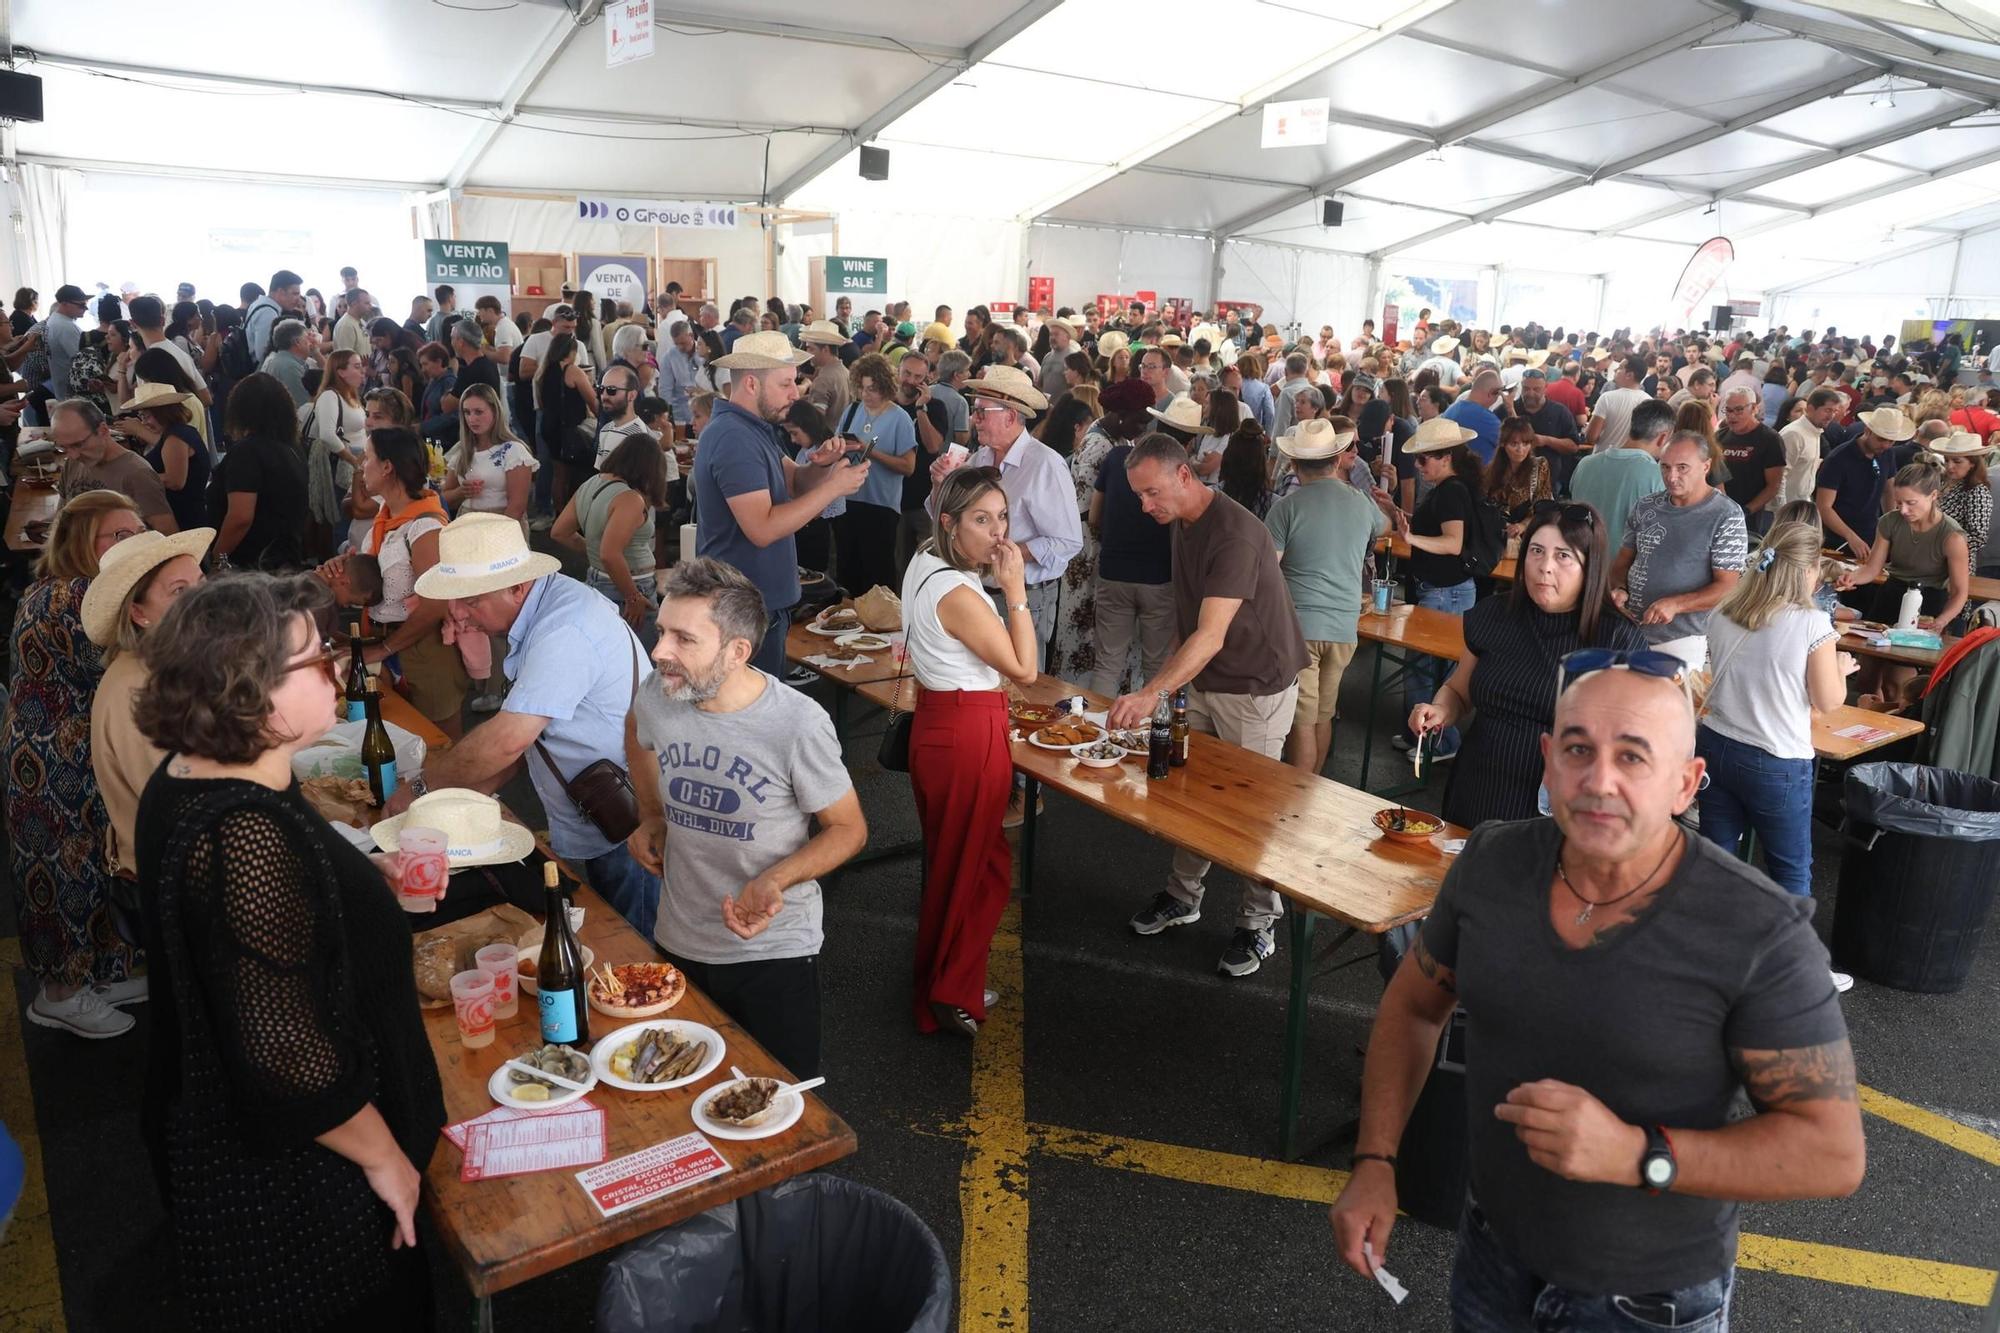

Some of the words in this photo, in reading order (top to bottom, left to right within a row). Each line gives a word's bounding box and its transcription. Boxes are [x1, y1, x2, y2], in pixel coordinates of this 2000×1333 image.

[441, 244, 497, 260] VENTA
[436, 263, 459, 278] DE
[462, 262, 504, 279] VIÑO
[842, 260, 875, 273] WINE
[595, 273, 632, 284] VENTA
[842, 276, 874, 289] SALE
[607, 287, 622, 298] DE
[657, 742, 721, 775] POLO
[724, 755, 772, 805] RL
[668, 807, 706, 830] ATHL.
[709, 818, 739, 837] DIV.
[586, 1155, 636, 1177] DEPOSITEN
[637, 1151, 650, 1160] OS
[604, 1153, 661, 1177] RECIPIENTES
[661, 1138, 704, 1156] SITUADOS
[601, 1183, 643, 1202] CRISTAL,
[643, 1166, 688, 1186] CAZOLAS,
[688, 1154, 717, 1170] VASOS
[634, 1162, 676, 1182] EXCEPTO
[614, 1197, 622, 1205] E
[622, 1183, 660, 1202] PRATOS
[659, 1179, 673, 1188] DE
[673, 1163, 715, 1183] MADEIRA
